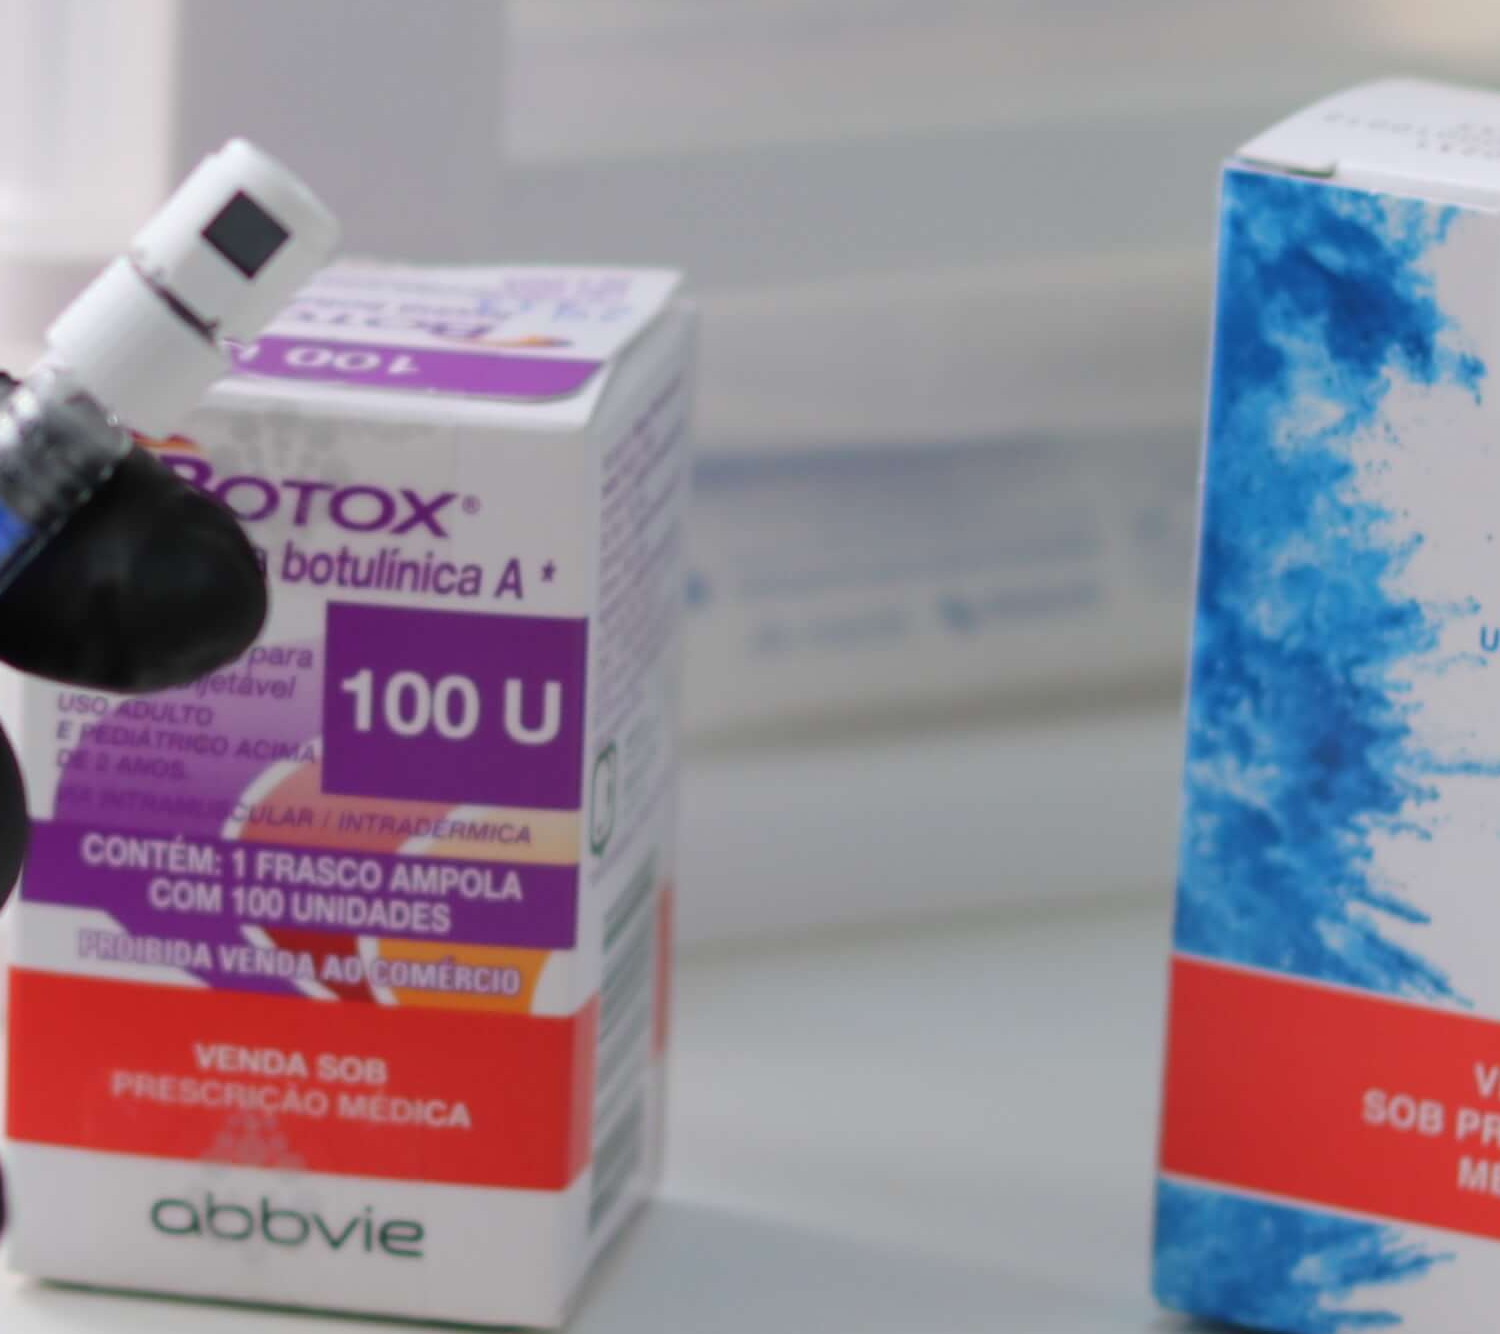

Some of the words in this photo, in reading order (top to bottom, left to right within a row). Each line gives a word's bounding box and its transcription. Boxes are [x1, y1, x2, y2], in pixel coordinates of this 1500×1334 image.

[281, 540, 483, 596] botulínica
[248, 644, 313, 672] para
[58, 692, 108, 716] USO
[115, 699, 216, 728] ADULTO
[176, 672, 297, 700] jetável
[341, 668, 481, 741] 100
[504, 680, 562, 746] U
[56, 720, 71, 740] E
[81, 722, 229, 757] PEDIÁTRICO
[233, 740, 317, 764] ACIMA
[56, 747, 87, 770] DE
[81, 832, 221, 876] CONTÉM:
[232, 849, 246, 878] 1
[256, 850, 382, 891] FRASCO
[390, 863, 525, 901] AMPOLA
[149, 878, 222, 912] COM
[232, 886, 285, 919] 100
[292, 893, 452, 933] UNIDADES
[78, 928, 212, 969] PROIBIDA
[219, 945, 316, 982] VENDA
[322, 953, 363, 982] AO
[371, 958, 521, 996] COMÉRCIO
[194, 1042, 308, 1079] VENDA
[317, 1054, 388, 1086] SOB
[111, 1071, 330, 1121] PRESCRIÇÃO
[337, 1090, 471, 1131] MÉDICA
[1361, 1089, 1444, 1136] SOB
[151, 1191, 427, 1258] abbvie
